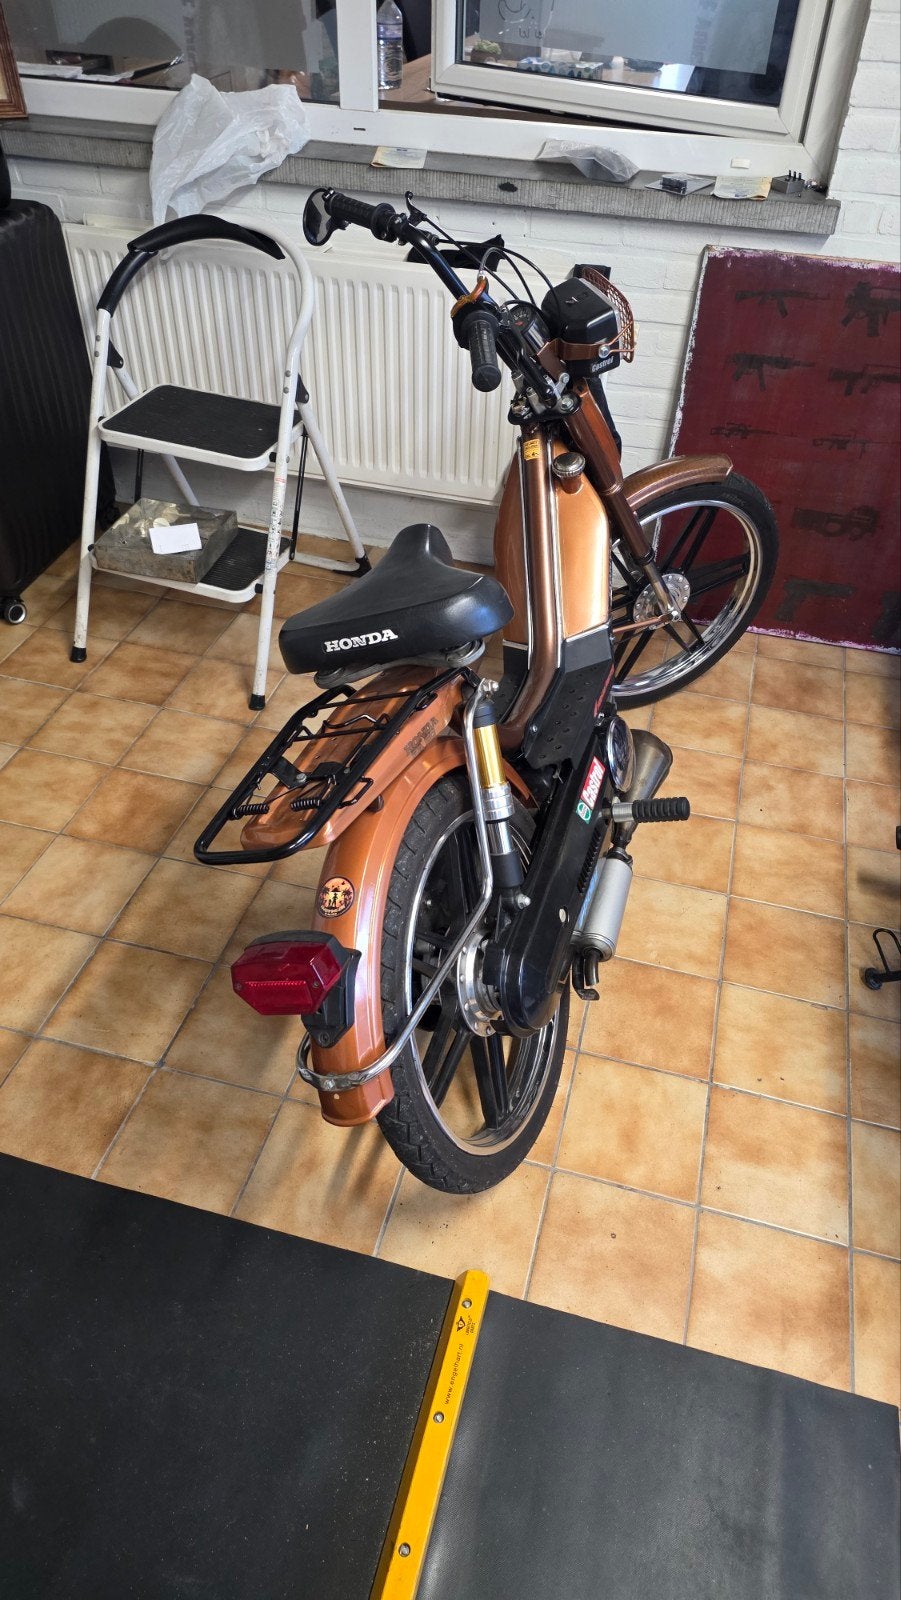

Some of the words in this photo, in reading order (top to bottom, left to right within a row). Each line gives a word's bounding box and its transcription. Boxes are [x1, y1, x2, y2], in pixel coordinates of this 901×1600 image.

[591, 355, 614, 372] Castrol
[324, 628, 399, 653] HONDA
[582, 759, 604, 809] Castrol
[444, 1343, 464, 1405] www.engelhart.nl
